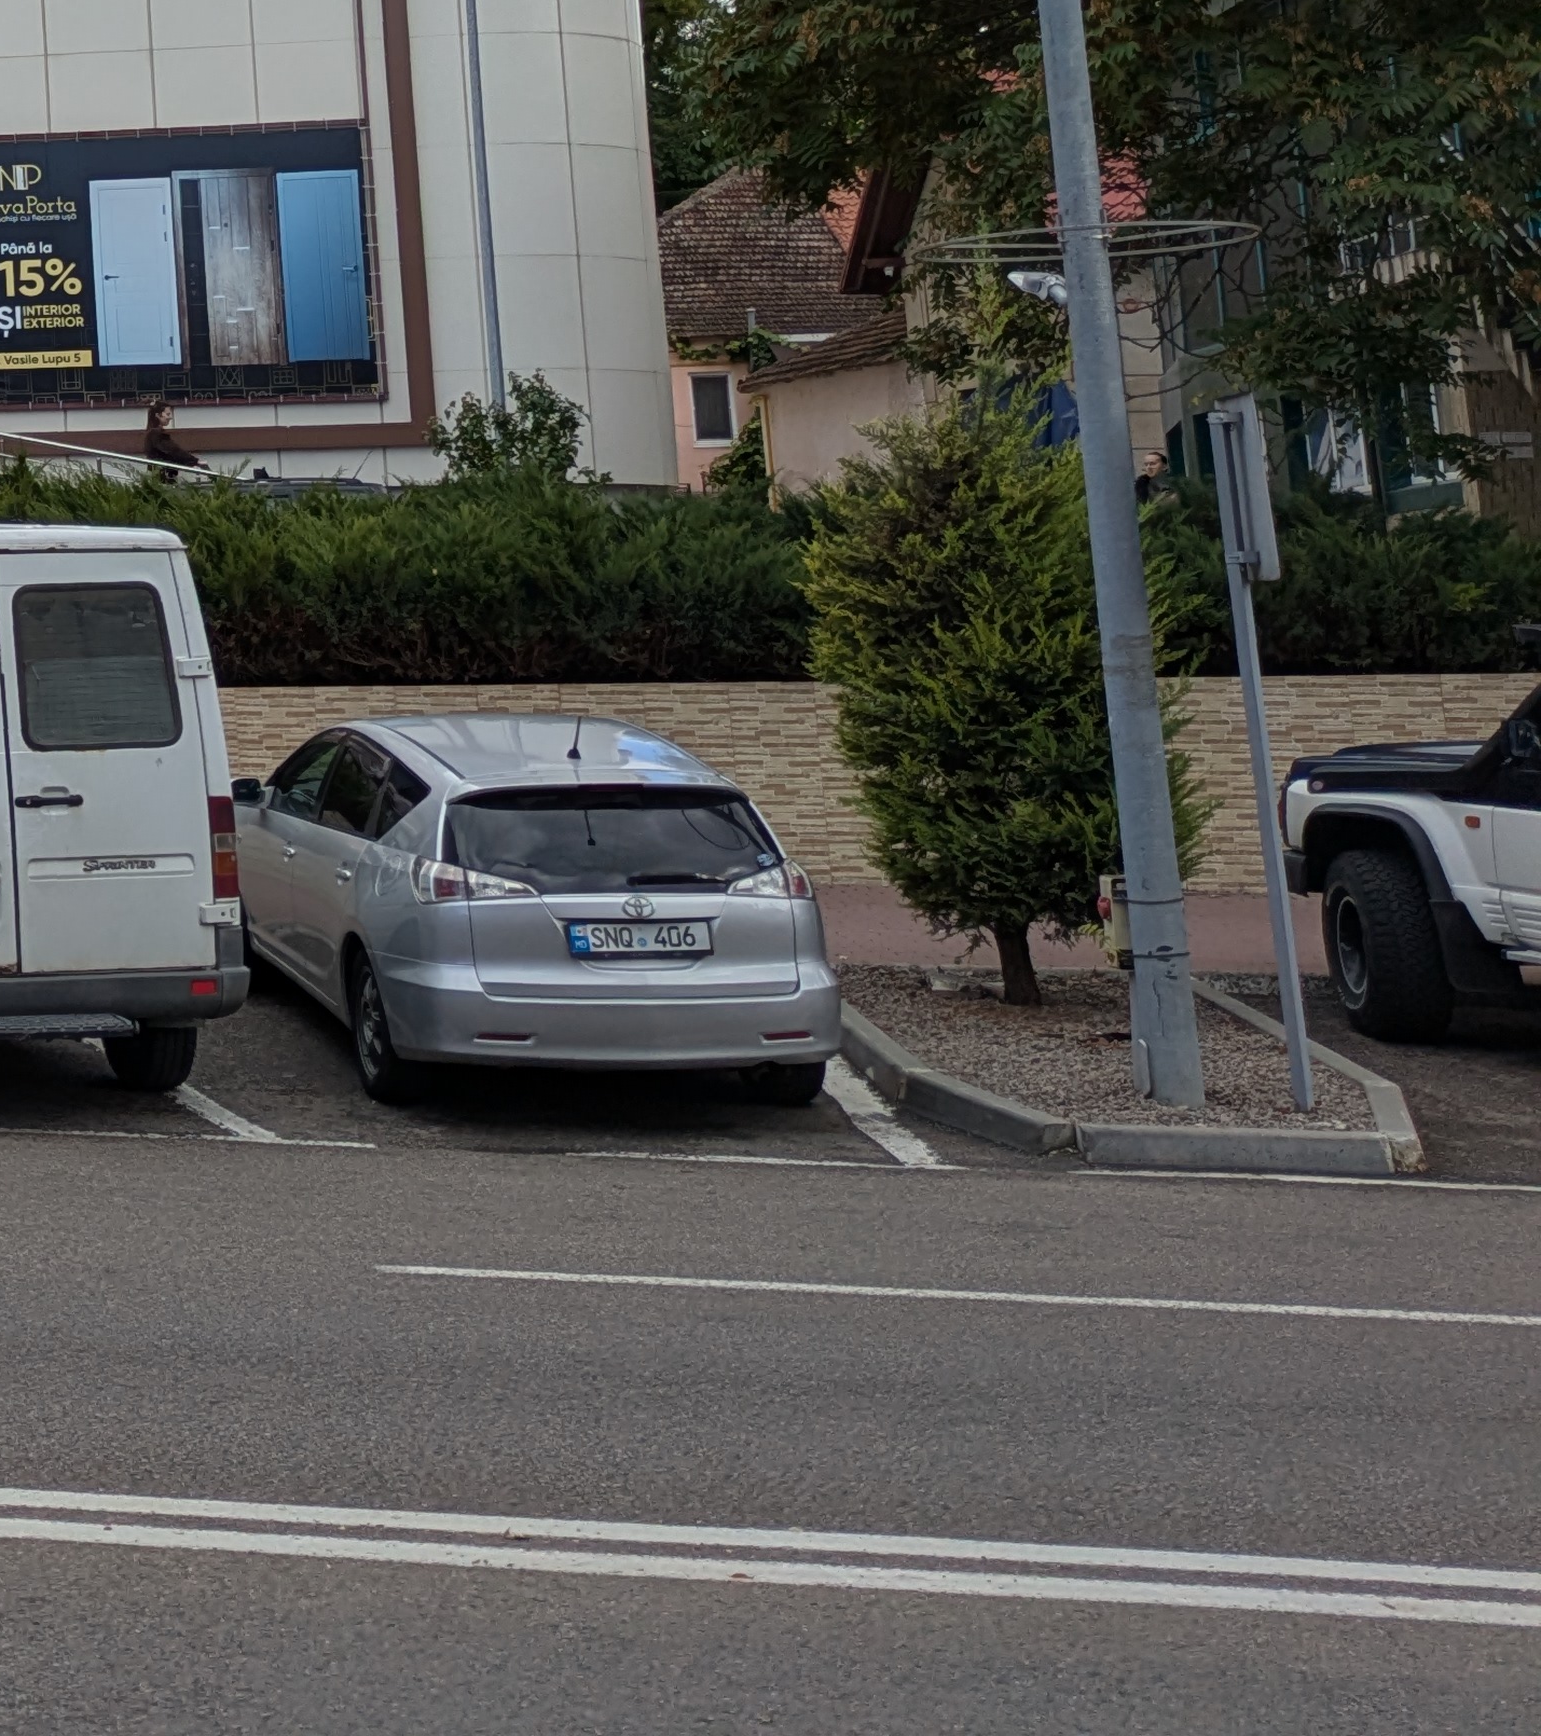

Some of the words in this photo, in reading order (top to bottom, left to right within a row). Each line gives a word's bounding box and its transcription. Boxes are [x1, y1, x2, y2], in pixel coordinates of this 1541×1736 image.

[0, 242, 36, 255] Până
[39, 242, 53, 254] la
[23, 303, 81, 316] INTERIOR
[23, 316, 85, 329] EXTERIOR
[4, 355, 39, 366] Vasile
[42, 353, 71, 366] Lupu
[74, 352, 81, 363] 5
[591, 926, 634, 949] SNQ
[654, 926, 696, 948] 406
